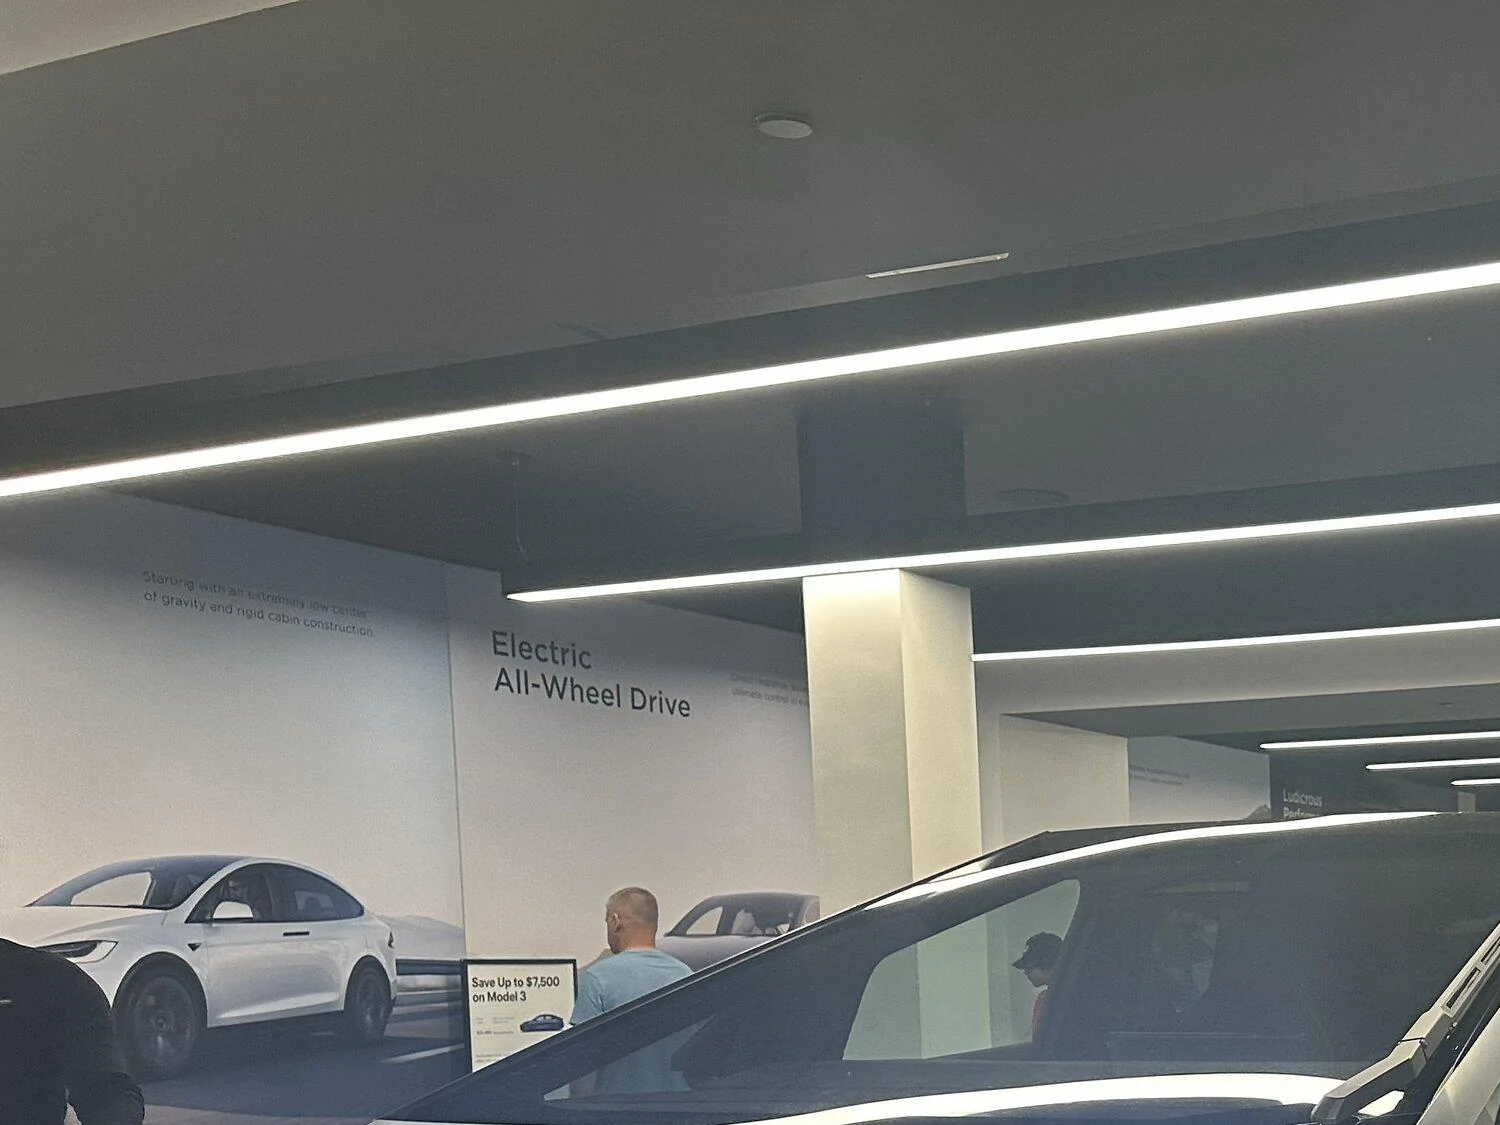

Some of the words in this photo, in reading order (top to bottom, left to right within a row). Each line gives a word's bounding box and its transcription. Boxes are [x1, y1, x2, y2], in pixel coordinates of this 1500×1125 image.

[142, 570, 195, 592] Starting
[309, 600, 329, 614] low
[144, 591, 158, 602] of
[162, 595, 207, 612] gravity
[210, 603, 233, 615] and
[237, 607, 265, 621] rigid
[268, 611, 300, 625] cabin
[492, 630, 592, 670] Electric
[494, 667, 622, 708] All-Wheel
[630, 687, 691, 717] Drive
[1283, 788, 1322, 807] Ludicrous
[472, 977, 496, 988] Save
[498, 977, 511, 989] Up
[514, 978, 523, 987] to
[526, 976, 560, 989] $7,500
[472, 993, 485, 1002] on
[487, 991, 518, 1002] Model
[520, 991, 527, 1001] 3
